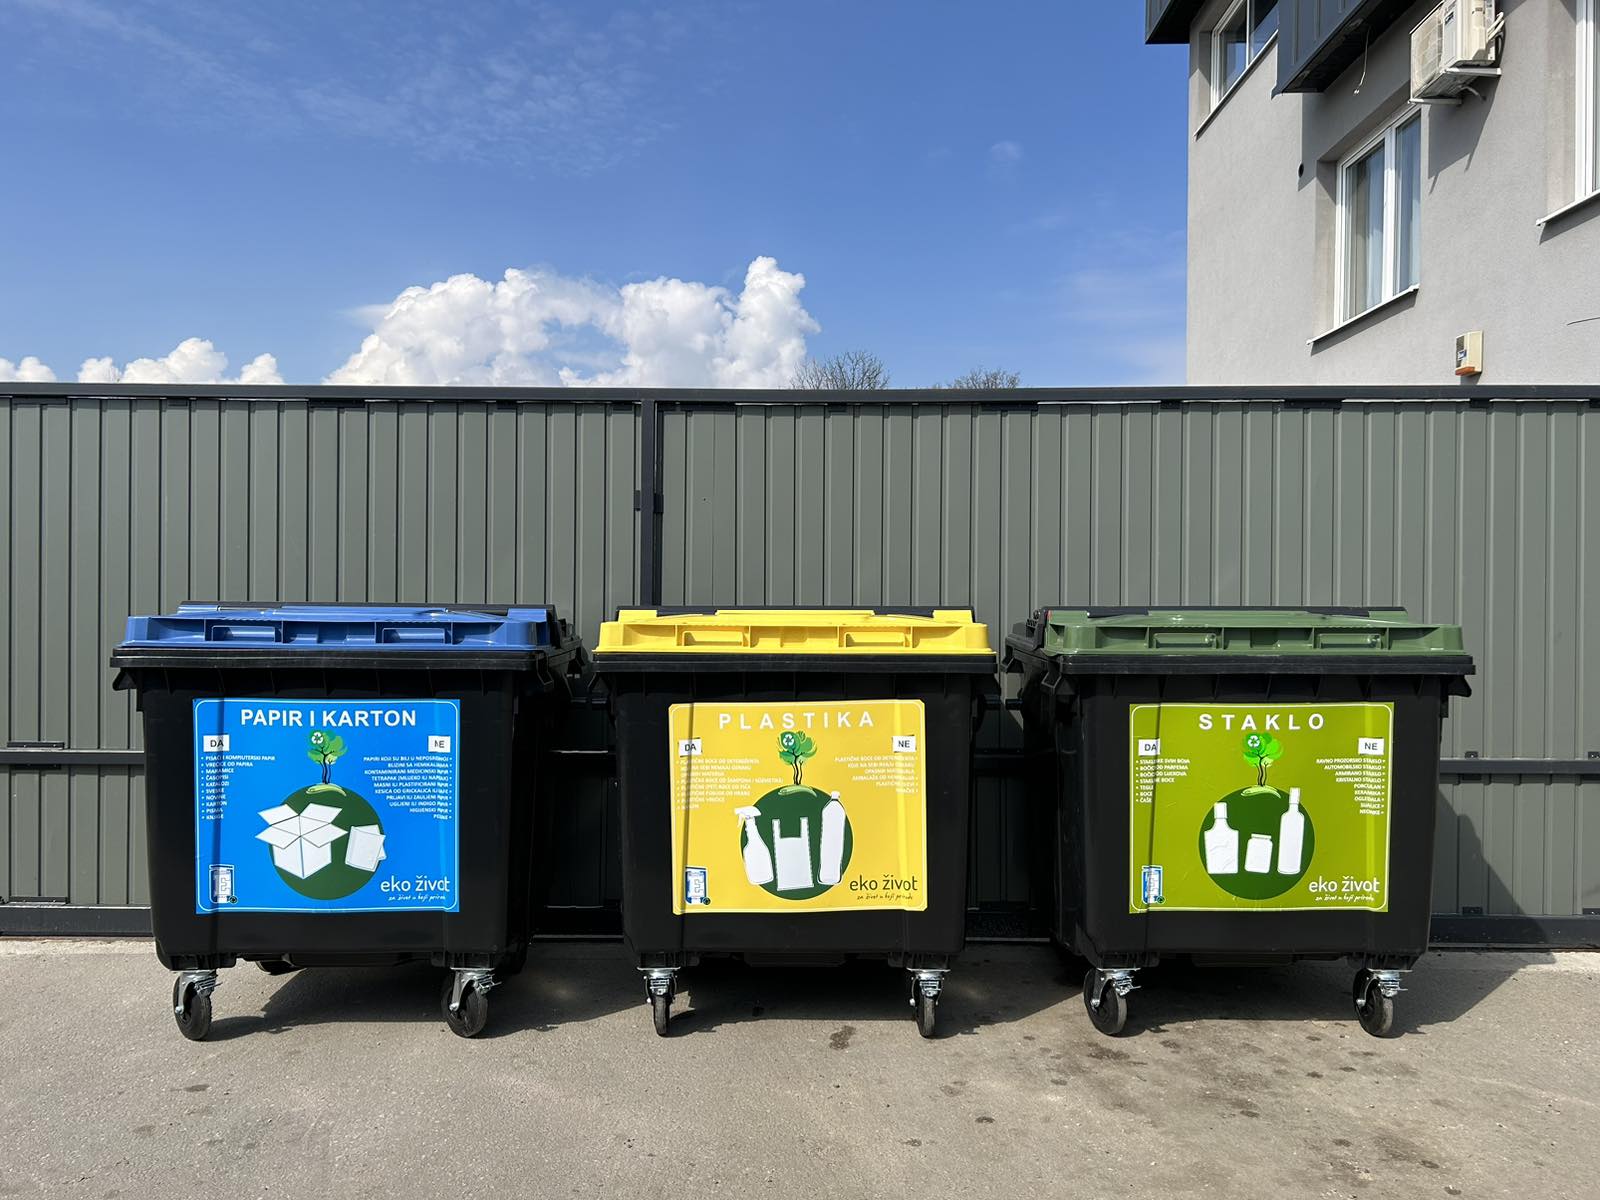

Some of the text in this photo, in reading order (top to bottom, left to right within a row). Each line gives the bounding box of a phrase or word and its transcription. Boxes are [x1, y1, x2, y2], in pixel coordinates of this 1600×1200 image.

[241, 709, 416, 727] PAPIR I KARTON
[719, 711, 874, 729] PLASTIKA
[1199, 713, 1324, 730] STAKLO
[210, 739, 224, 747] DA
[434, 740, 445, 748] NE
[684, 743, 697, 751] DA
[898, 740, 910, 748] NE
[1144, 744, 1157, 752] DA
[1364, 742, 1378, 751] NE
[380, 875, 450, 892] eko život
[849, 874, 918, 891] eko život
[1308, 875, 1380, 893] eko život
